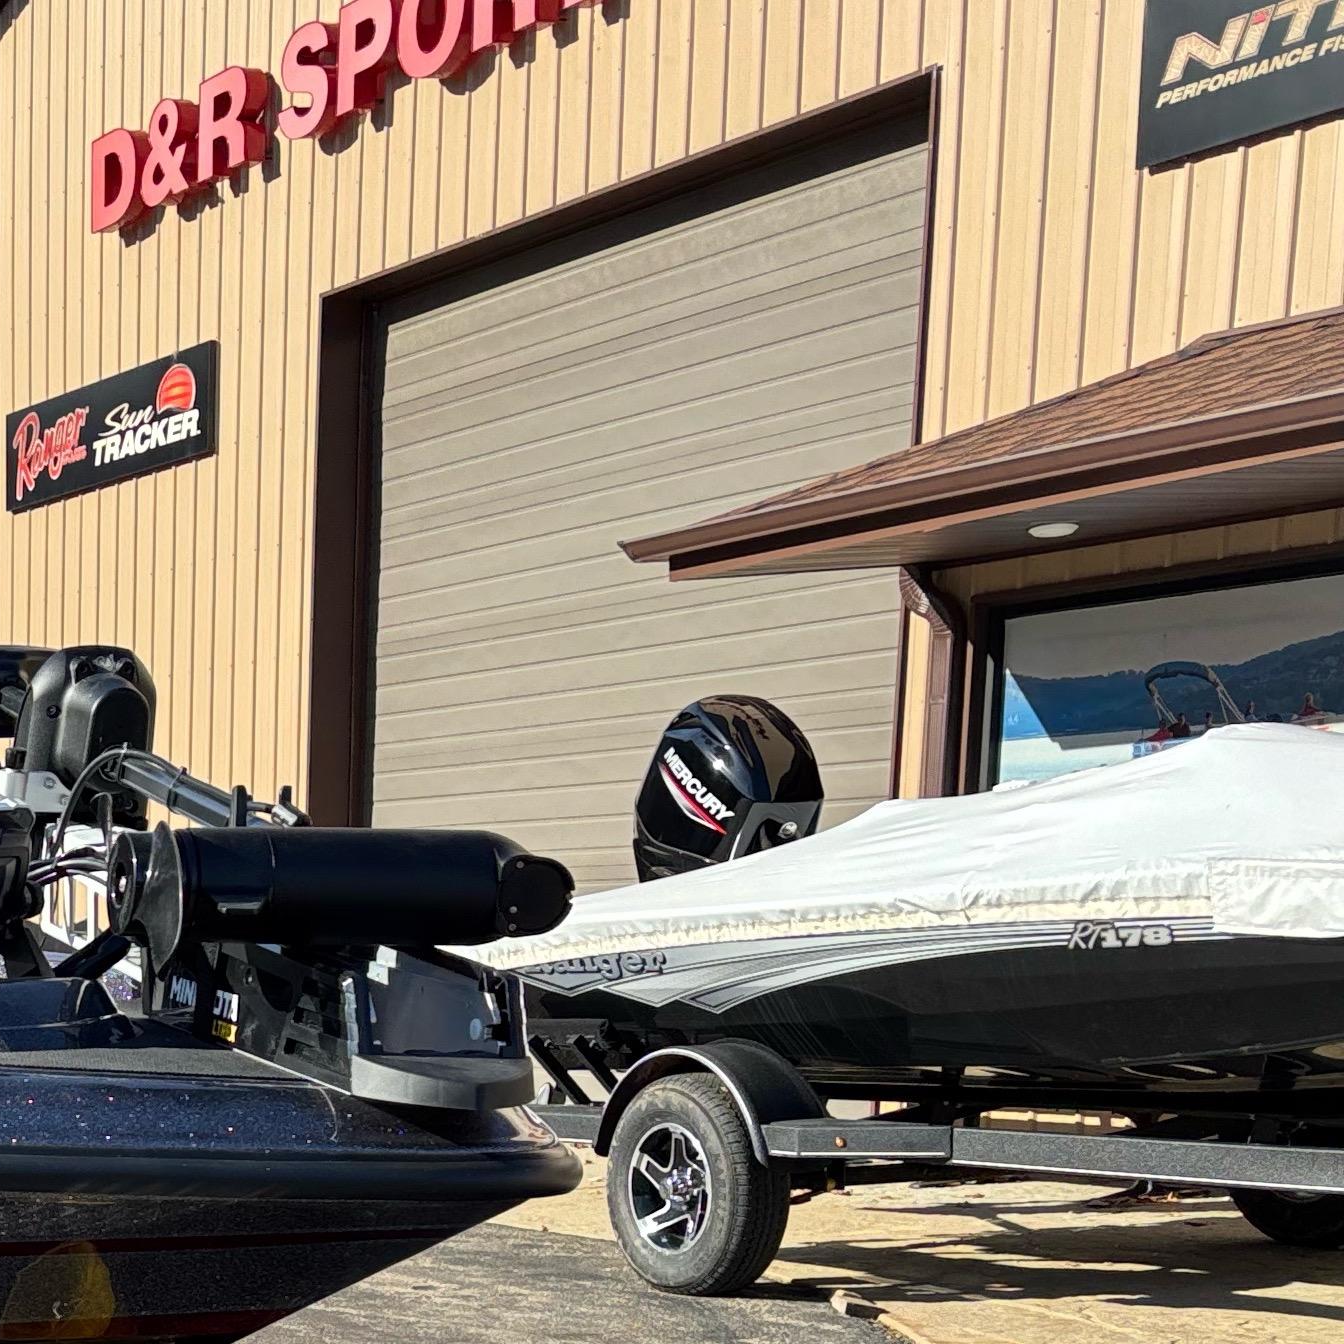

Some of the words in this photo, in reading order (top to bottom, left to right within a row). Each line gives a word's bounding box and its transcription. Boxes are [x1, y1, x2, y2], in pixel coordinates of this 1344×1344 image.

[1155, 43, 1318, 109] PERFORMANCE
[91, 65, 257, 234] D&R
[98, 402, 154, 437] Sun
[13, 410, 89, 501] Ranger
[663, 746, 735, 821] MERCURY
[169, 975, 197, 1007] MIN
[524, 951, 667, 981] anger
